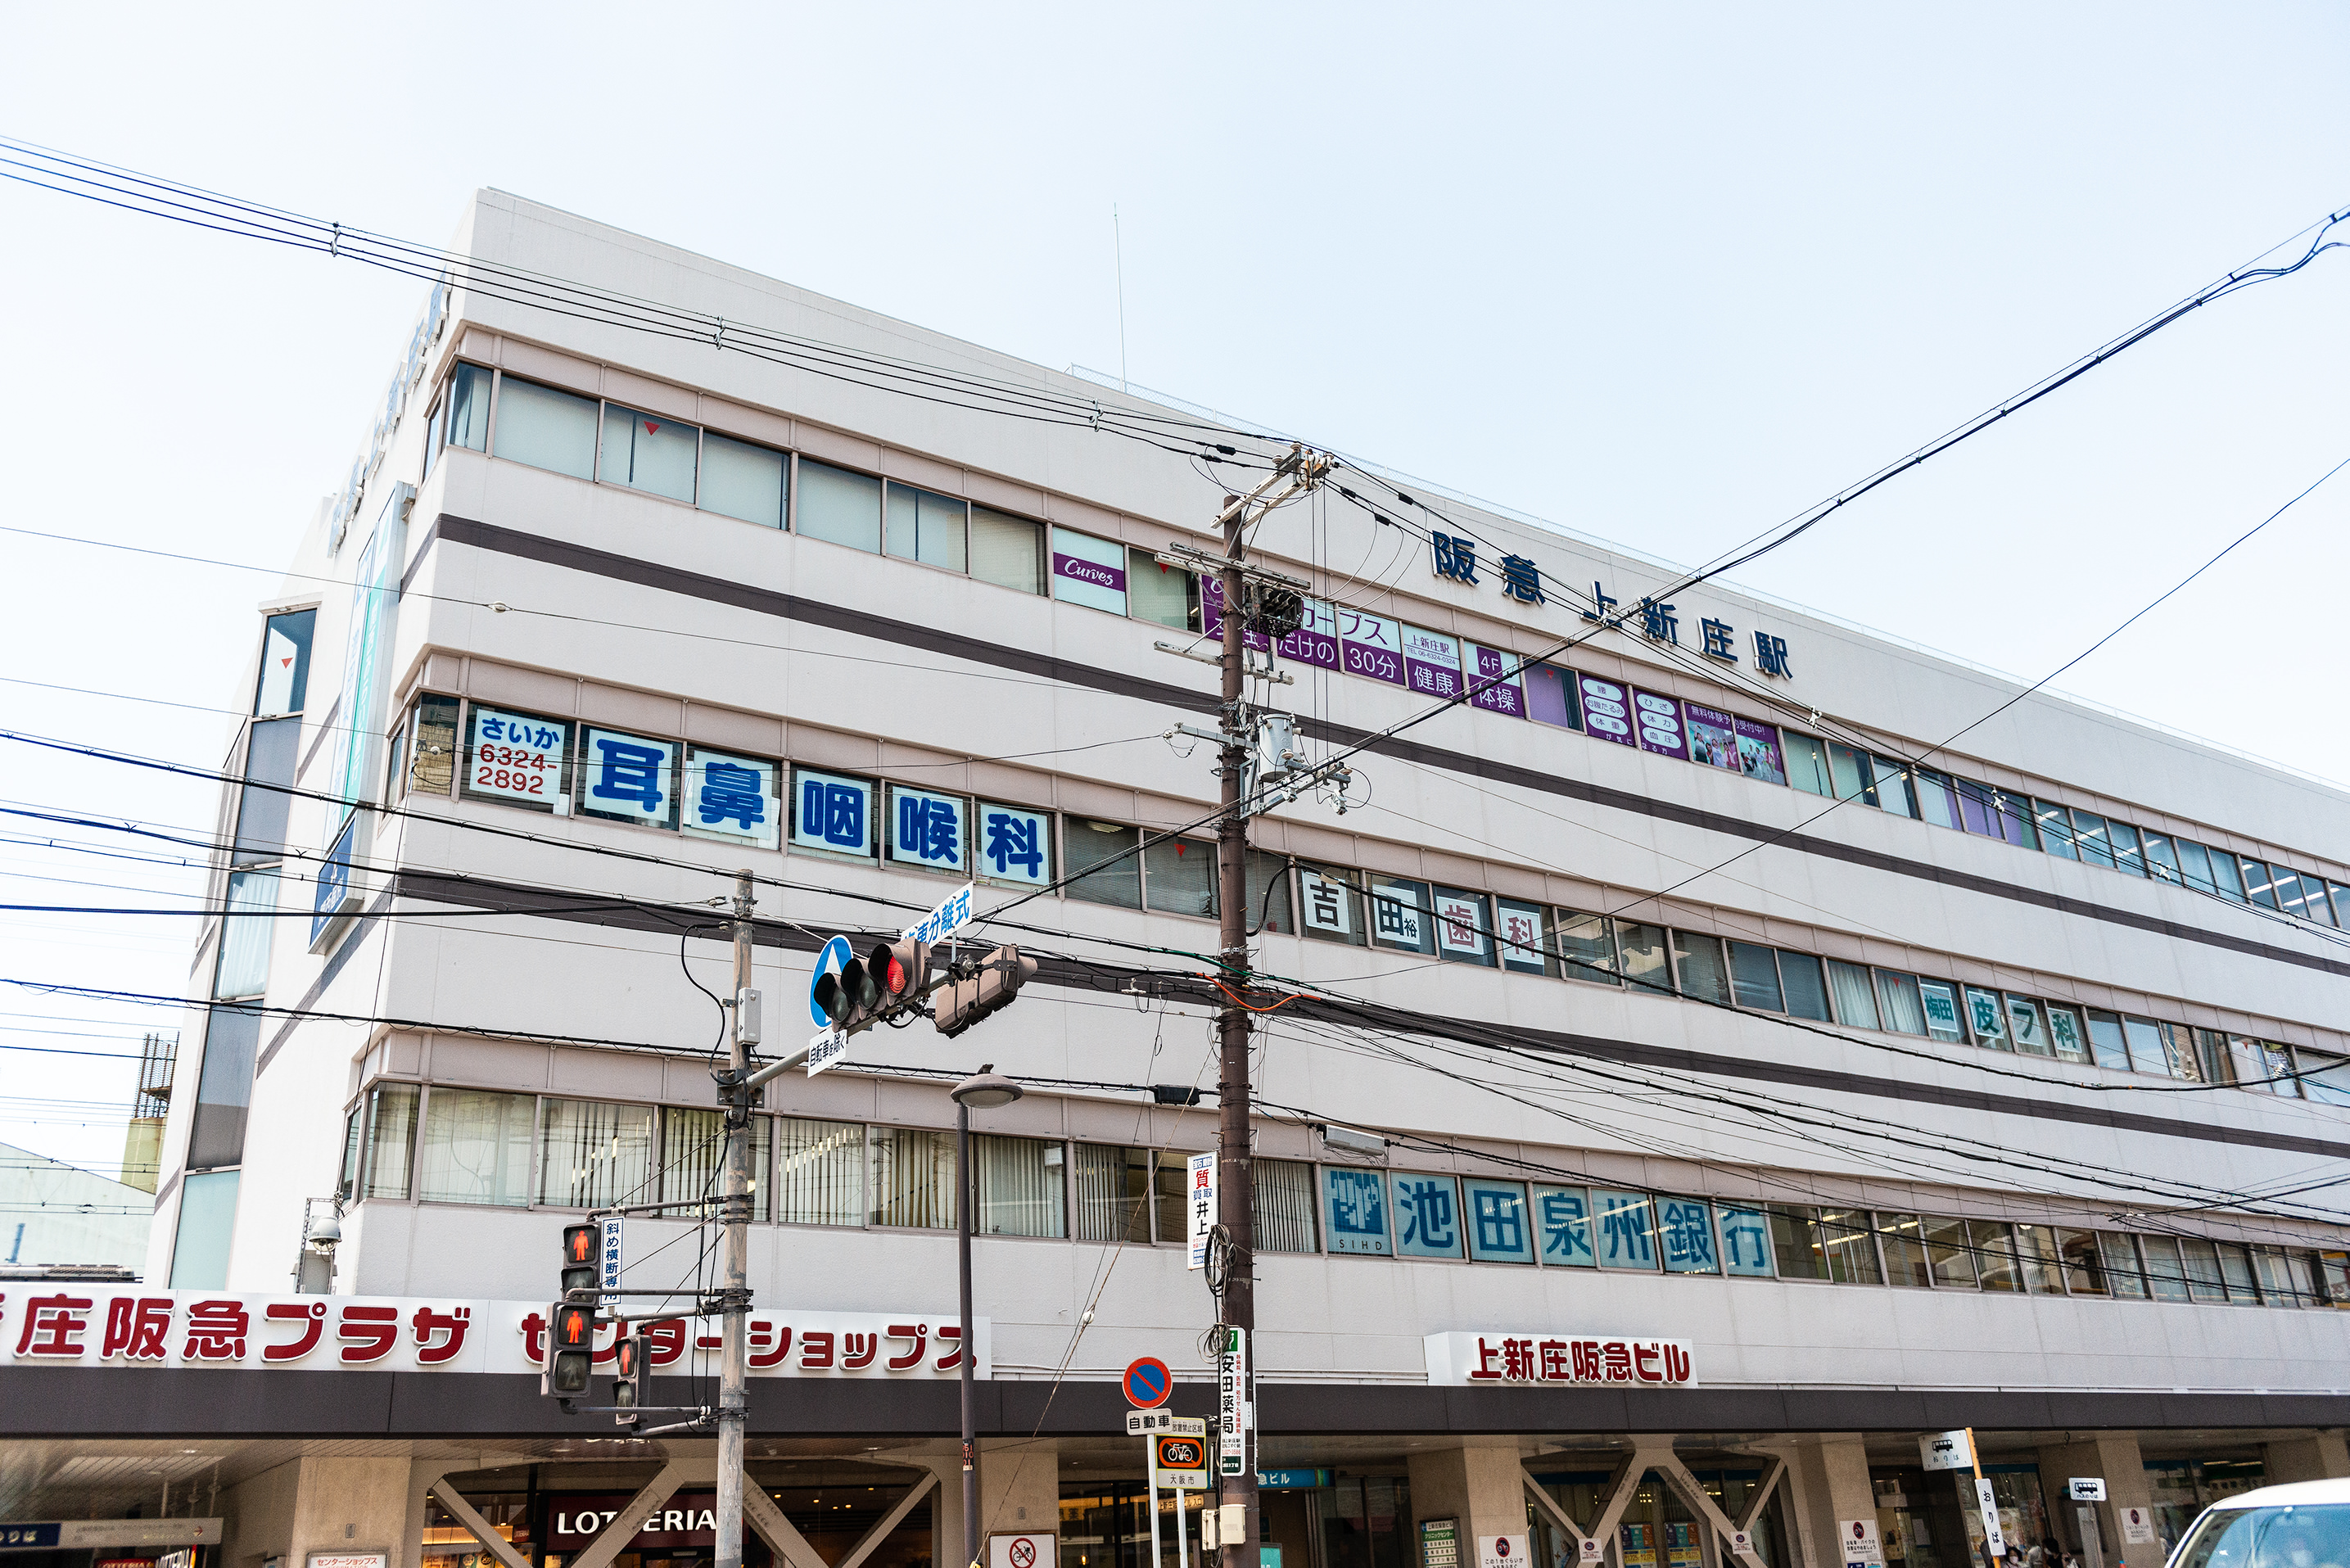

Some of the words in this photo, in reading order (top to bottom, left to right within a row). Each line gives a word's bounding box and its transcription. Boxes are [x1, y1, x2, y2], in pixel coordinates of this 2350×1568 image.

[1064, 559, 1114, 587] Curves
[1407, 646, 1417, 654] TEL
[1411, 635, 1450, 655] 上新庄駅
[1480, 655, 1498, 671] 4F
[1643, 698, 1668, 712] ひざ
[481, 718, 560, 748] さいか
[1647, 715, 1671, 728] 体力
[1650, 731, 1674, 744] 血圧
[480, 743, 558, 772] 6324-
[477, 766, 544, 795] 2892
[592, 737, 1044, 879] 耳鼻咽喉科
[904, 889, 969, 945] 車分離式
[1195, 1168, 1209, 1190] 質
[1193, 1188, 1213, 1201] 買取
[1196, 1200, 1209, 1236] 井上
[1399, 1179, 1765, 1269] 池田泉州銀行
[1339, 1239, 1383, 1251] SIHD
[0, 1293, 472, 1365] 庄阪急プラザ
[1467, 1336, 1690, 1384] 上新庄阪急ビル
[1222, 1354, 1234, 1435] 安田薬局
[1129, 1414, 1171, 1430] 自動車
[1170, 1475, 1195, 1484] 大阪市
[1159, 1499, 1193, 1512] 上新庄阪ビル
[1983, 1490, 2000, 1544] おりば
[558, 1509, 717, 1534] LOTERIA
[316, 1557, 378, 1566] センターショップス
